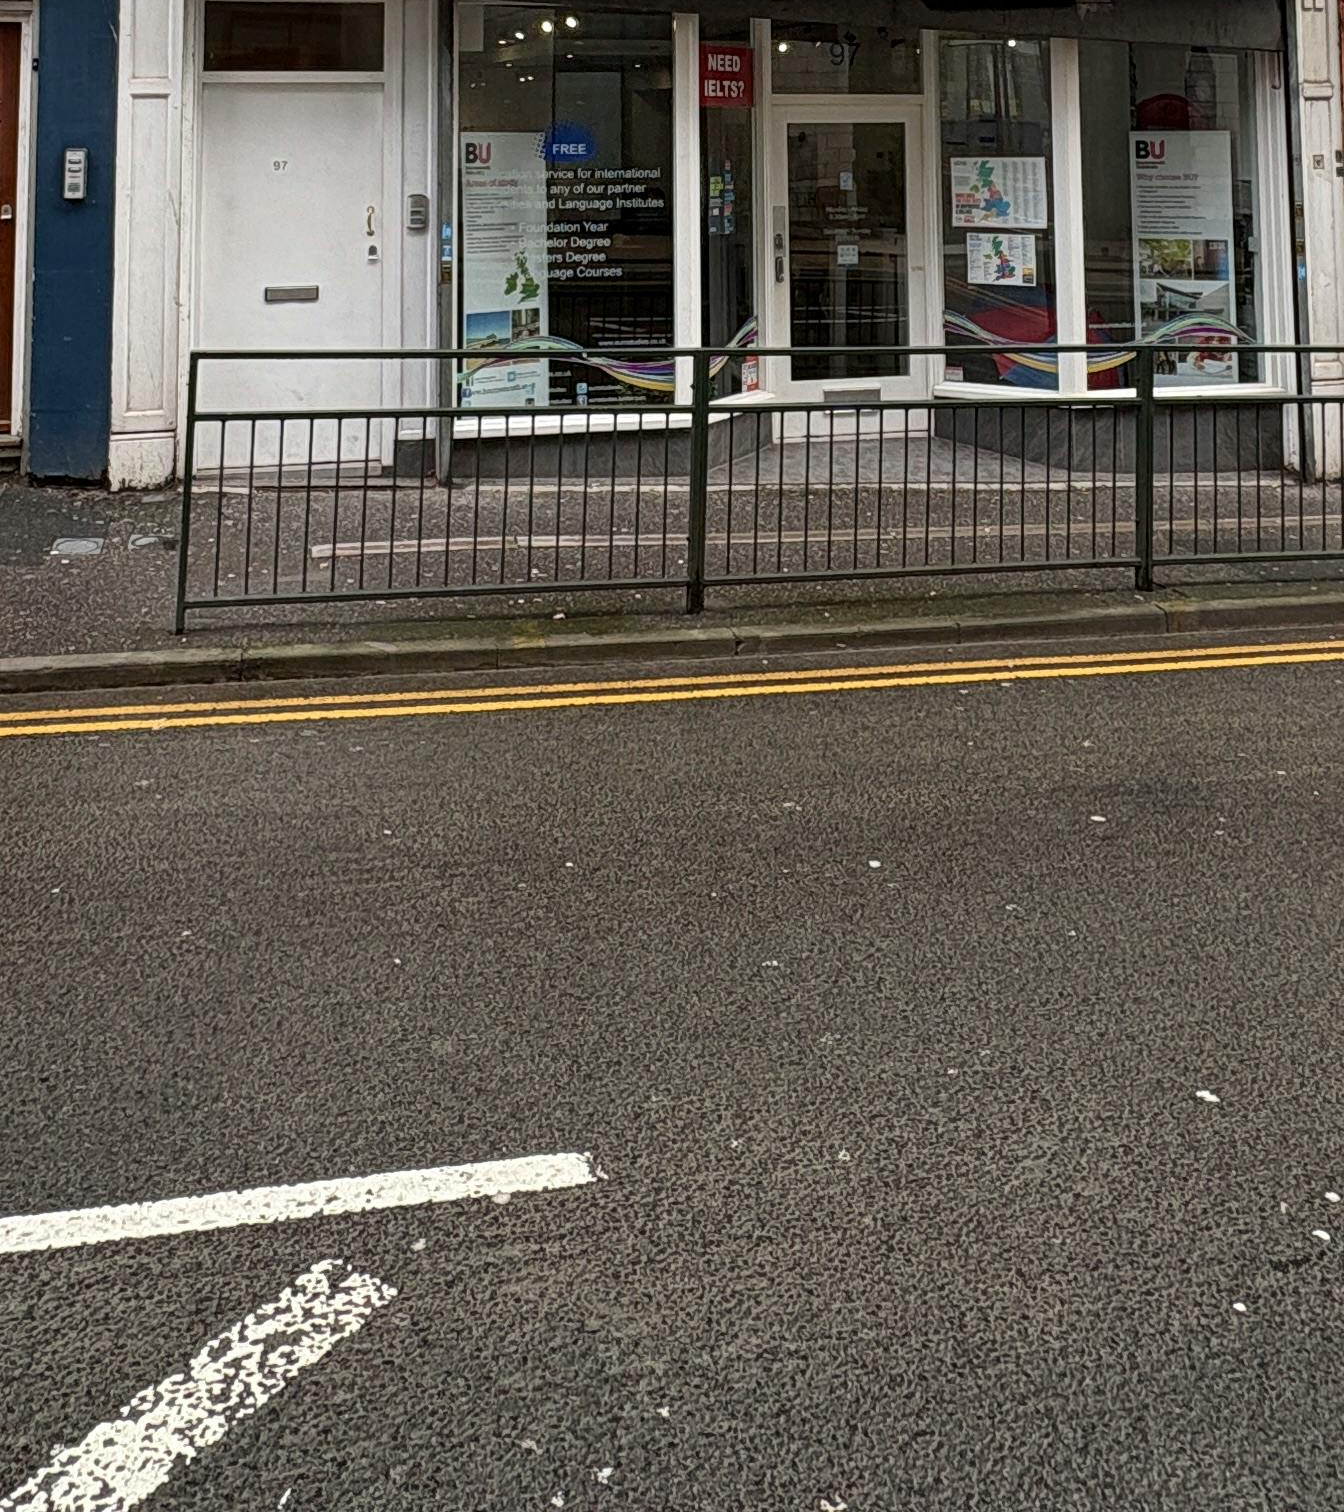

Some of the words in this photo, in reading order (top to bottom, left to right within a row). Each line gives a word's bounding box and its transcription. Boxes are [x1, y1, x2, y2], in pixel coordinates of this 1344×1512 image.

[707, 53, 741, 72] NEED
[704, 79, 745, 98] IELTS?
[464, 141, 492, 164] BU
[552, 143, 587, 155] FREE
[1135, 139, 1165, 160] BU
[273, 160, 288, 171] 97
[577, 167, 592, 179] for
[594, 166, 661, 179] international
[550, 185, 571, 197] any
[573, 184, 585, 194] of
[587, 185, 605, 194] our
[608, 183, 647, 196] partner
[558, 199, 614, 212] Language
[616, 198, 665, 209] Institutes
[519, 222, 581, 233] Foundation
[583, 222, 609, 232] Year
[570, 237, 612, 249] Degree
[565, 252, 607, 265] Degree
[576, 266, 623, 278] Courses
